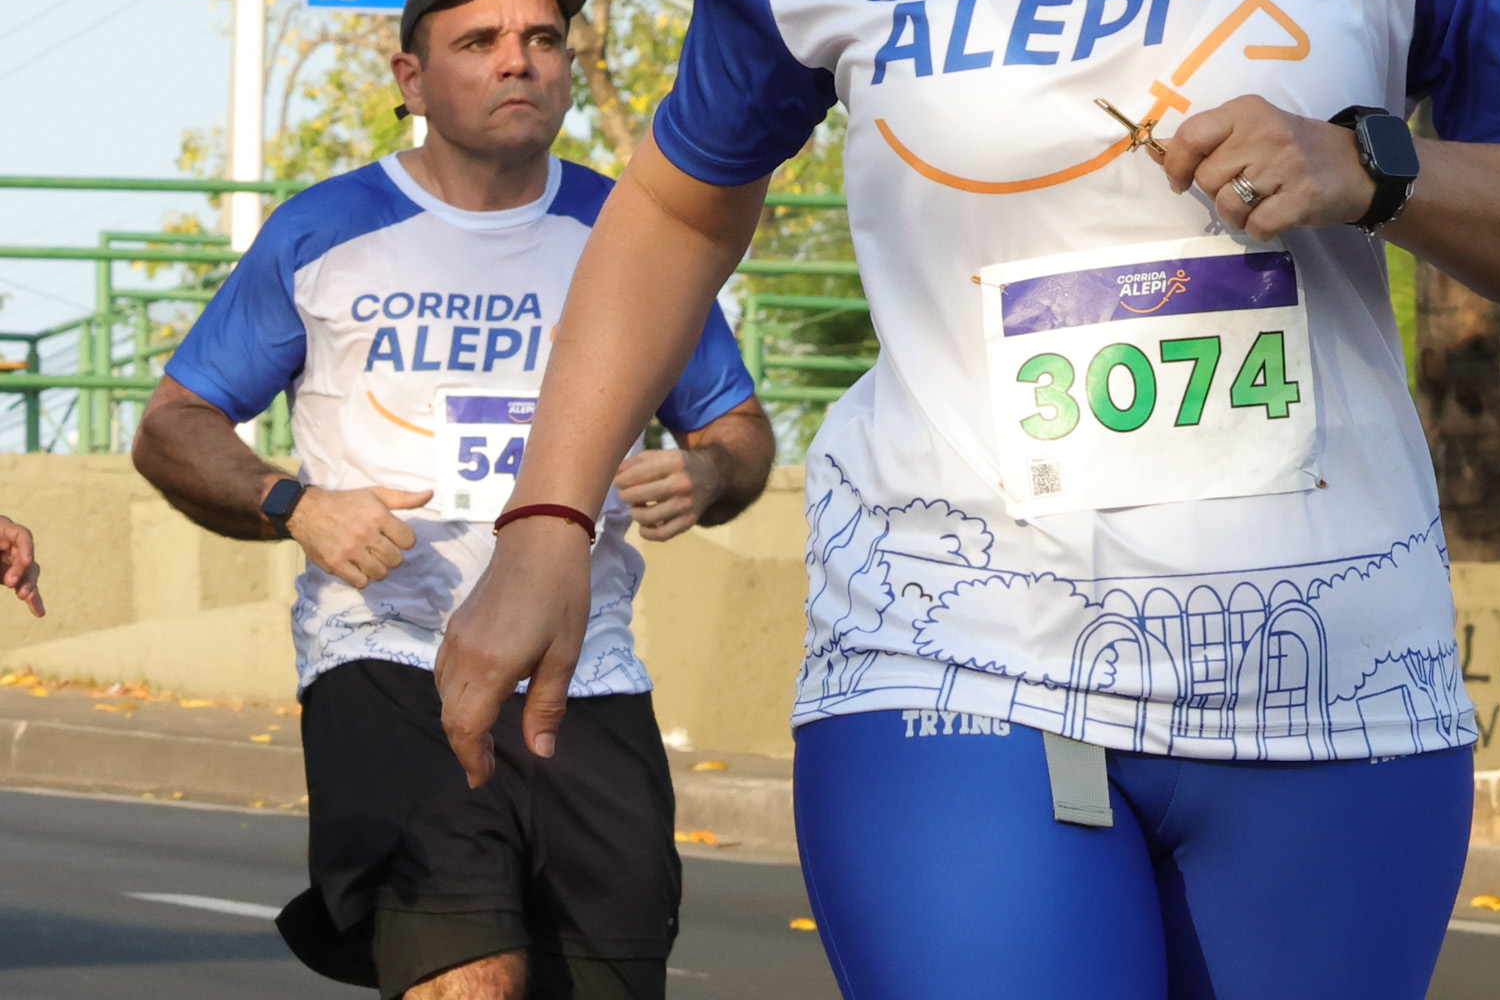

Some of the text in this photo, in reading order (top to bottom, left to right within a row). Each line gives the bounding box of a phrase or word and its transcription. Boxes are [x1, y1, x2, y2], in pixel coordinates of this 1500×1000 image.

[1117, 270, 1166, 285] CORRIDA
[1119, 280, 1168, 297] ALEPI
[351, 292, 542, 322] CORRIDA
[364, 325, 542, 372] ALEPI
[1016, 330, 1301, 441] 3074
[902, 709, 1010, 737] TRYING
